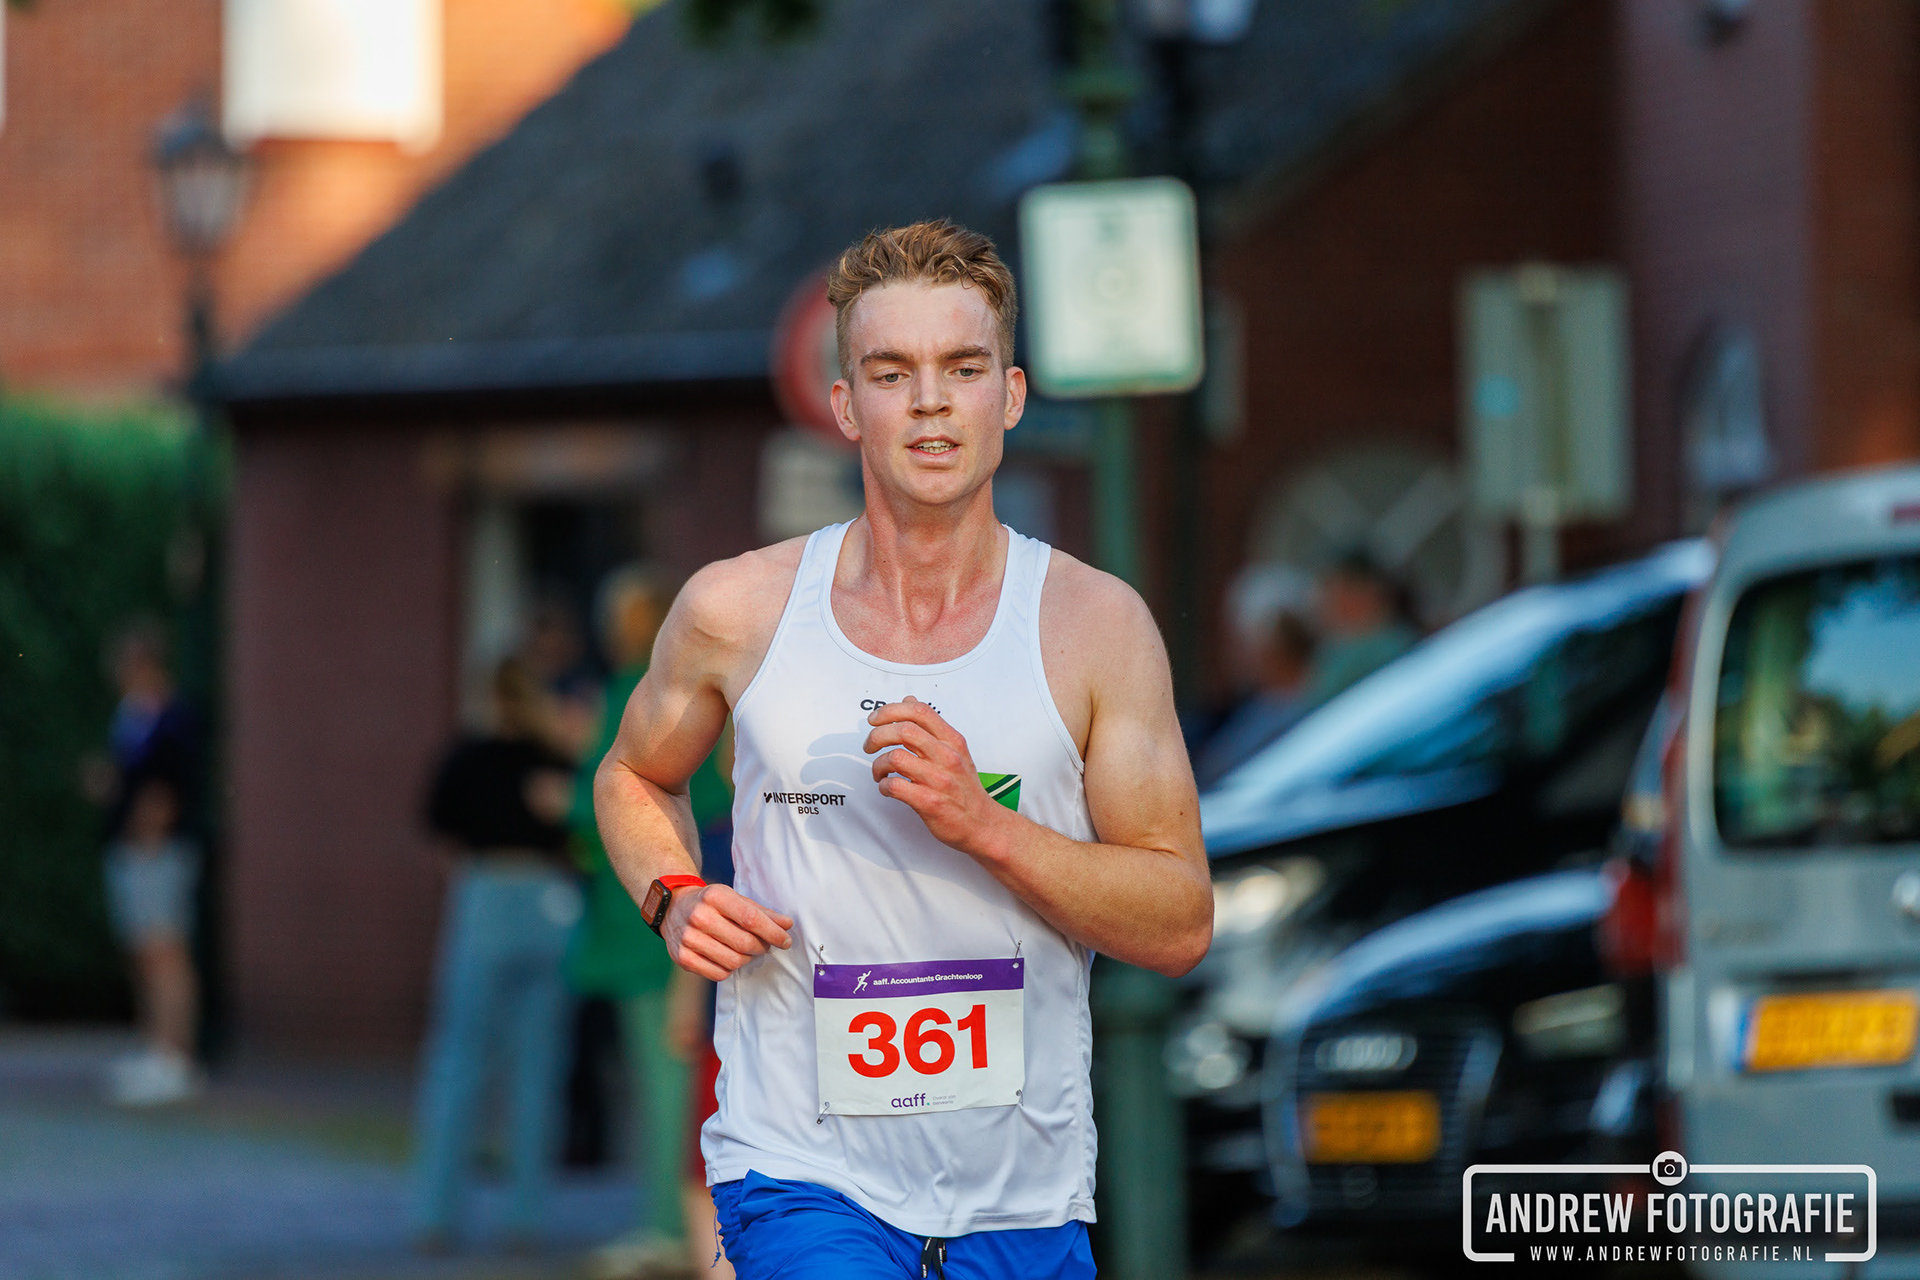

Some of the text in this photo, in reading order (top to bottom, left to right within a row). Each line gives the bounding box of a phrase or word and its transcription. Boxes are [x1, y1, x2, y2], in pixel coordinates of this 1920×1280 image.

[772, 792, 846, 806] INTERSPORT
[797, 806, 820, 815] BOLS
[890, 974, 934, 985] Accountants
[935, 973, 983, 981] Grachtenloop
[848, 1004, 988, 1078] 361
